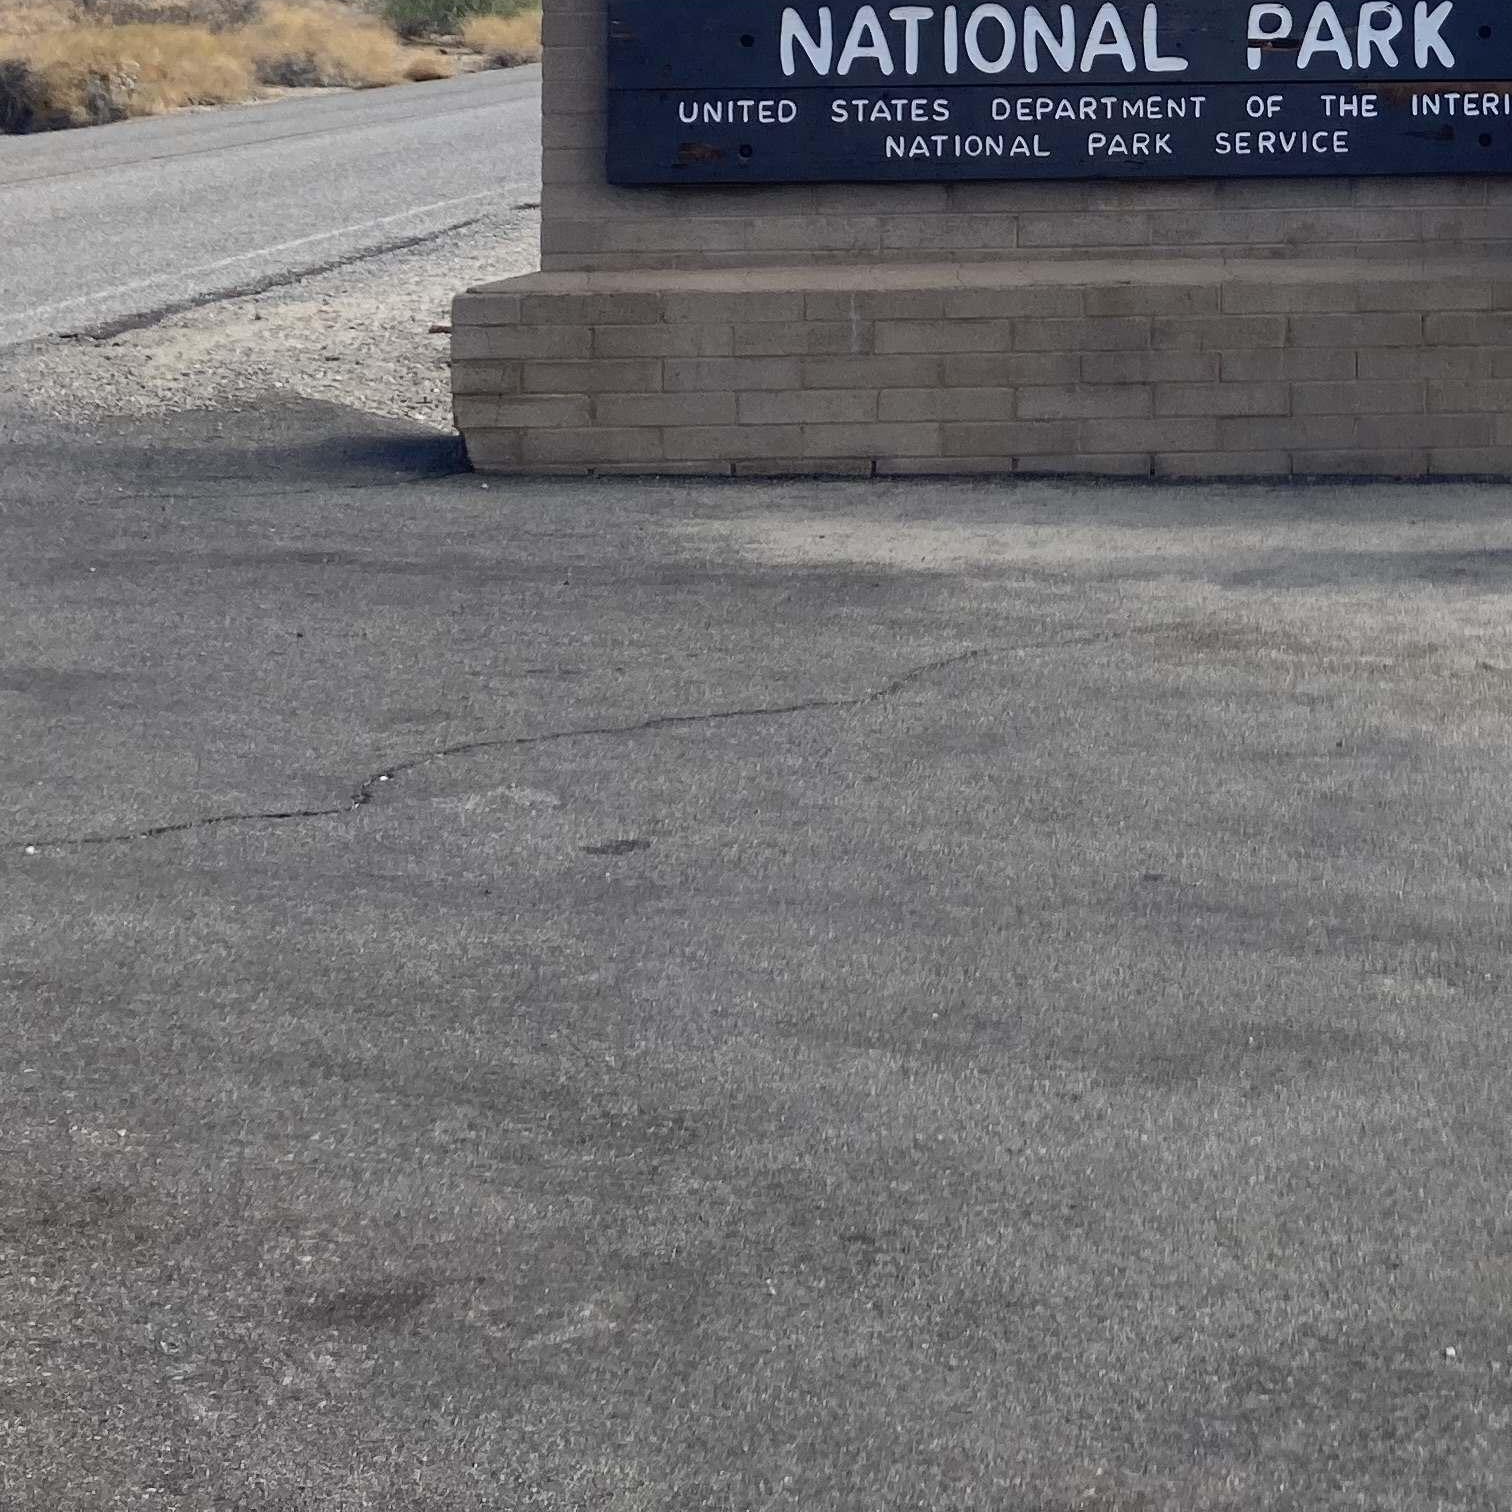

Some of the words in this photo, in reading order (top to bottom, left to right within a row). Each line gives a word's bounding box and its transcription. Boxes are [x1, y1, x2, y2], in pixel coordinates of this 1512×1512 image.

[780, 2, 1189, 77] NATIONAL
[1246, 0, 1455, 71] PARK
[678, 99, 797, 124] UNITED
[831, 98, 950, 123] STATES
[991, 95, 1206, 121] DEPARTMENT
[1246, 95, 1283, 118] OF
[1320, 94, 1378, 118] THE
[885, 134, 1051, 158] NATIONAL
[1088, 132, 1172, 156] PARK
[1215, 130, 1349, 154] SERVICE
